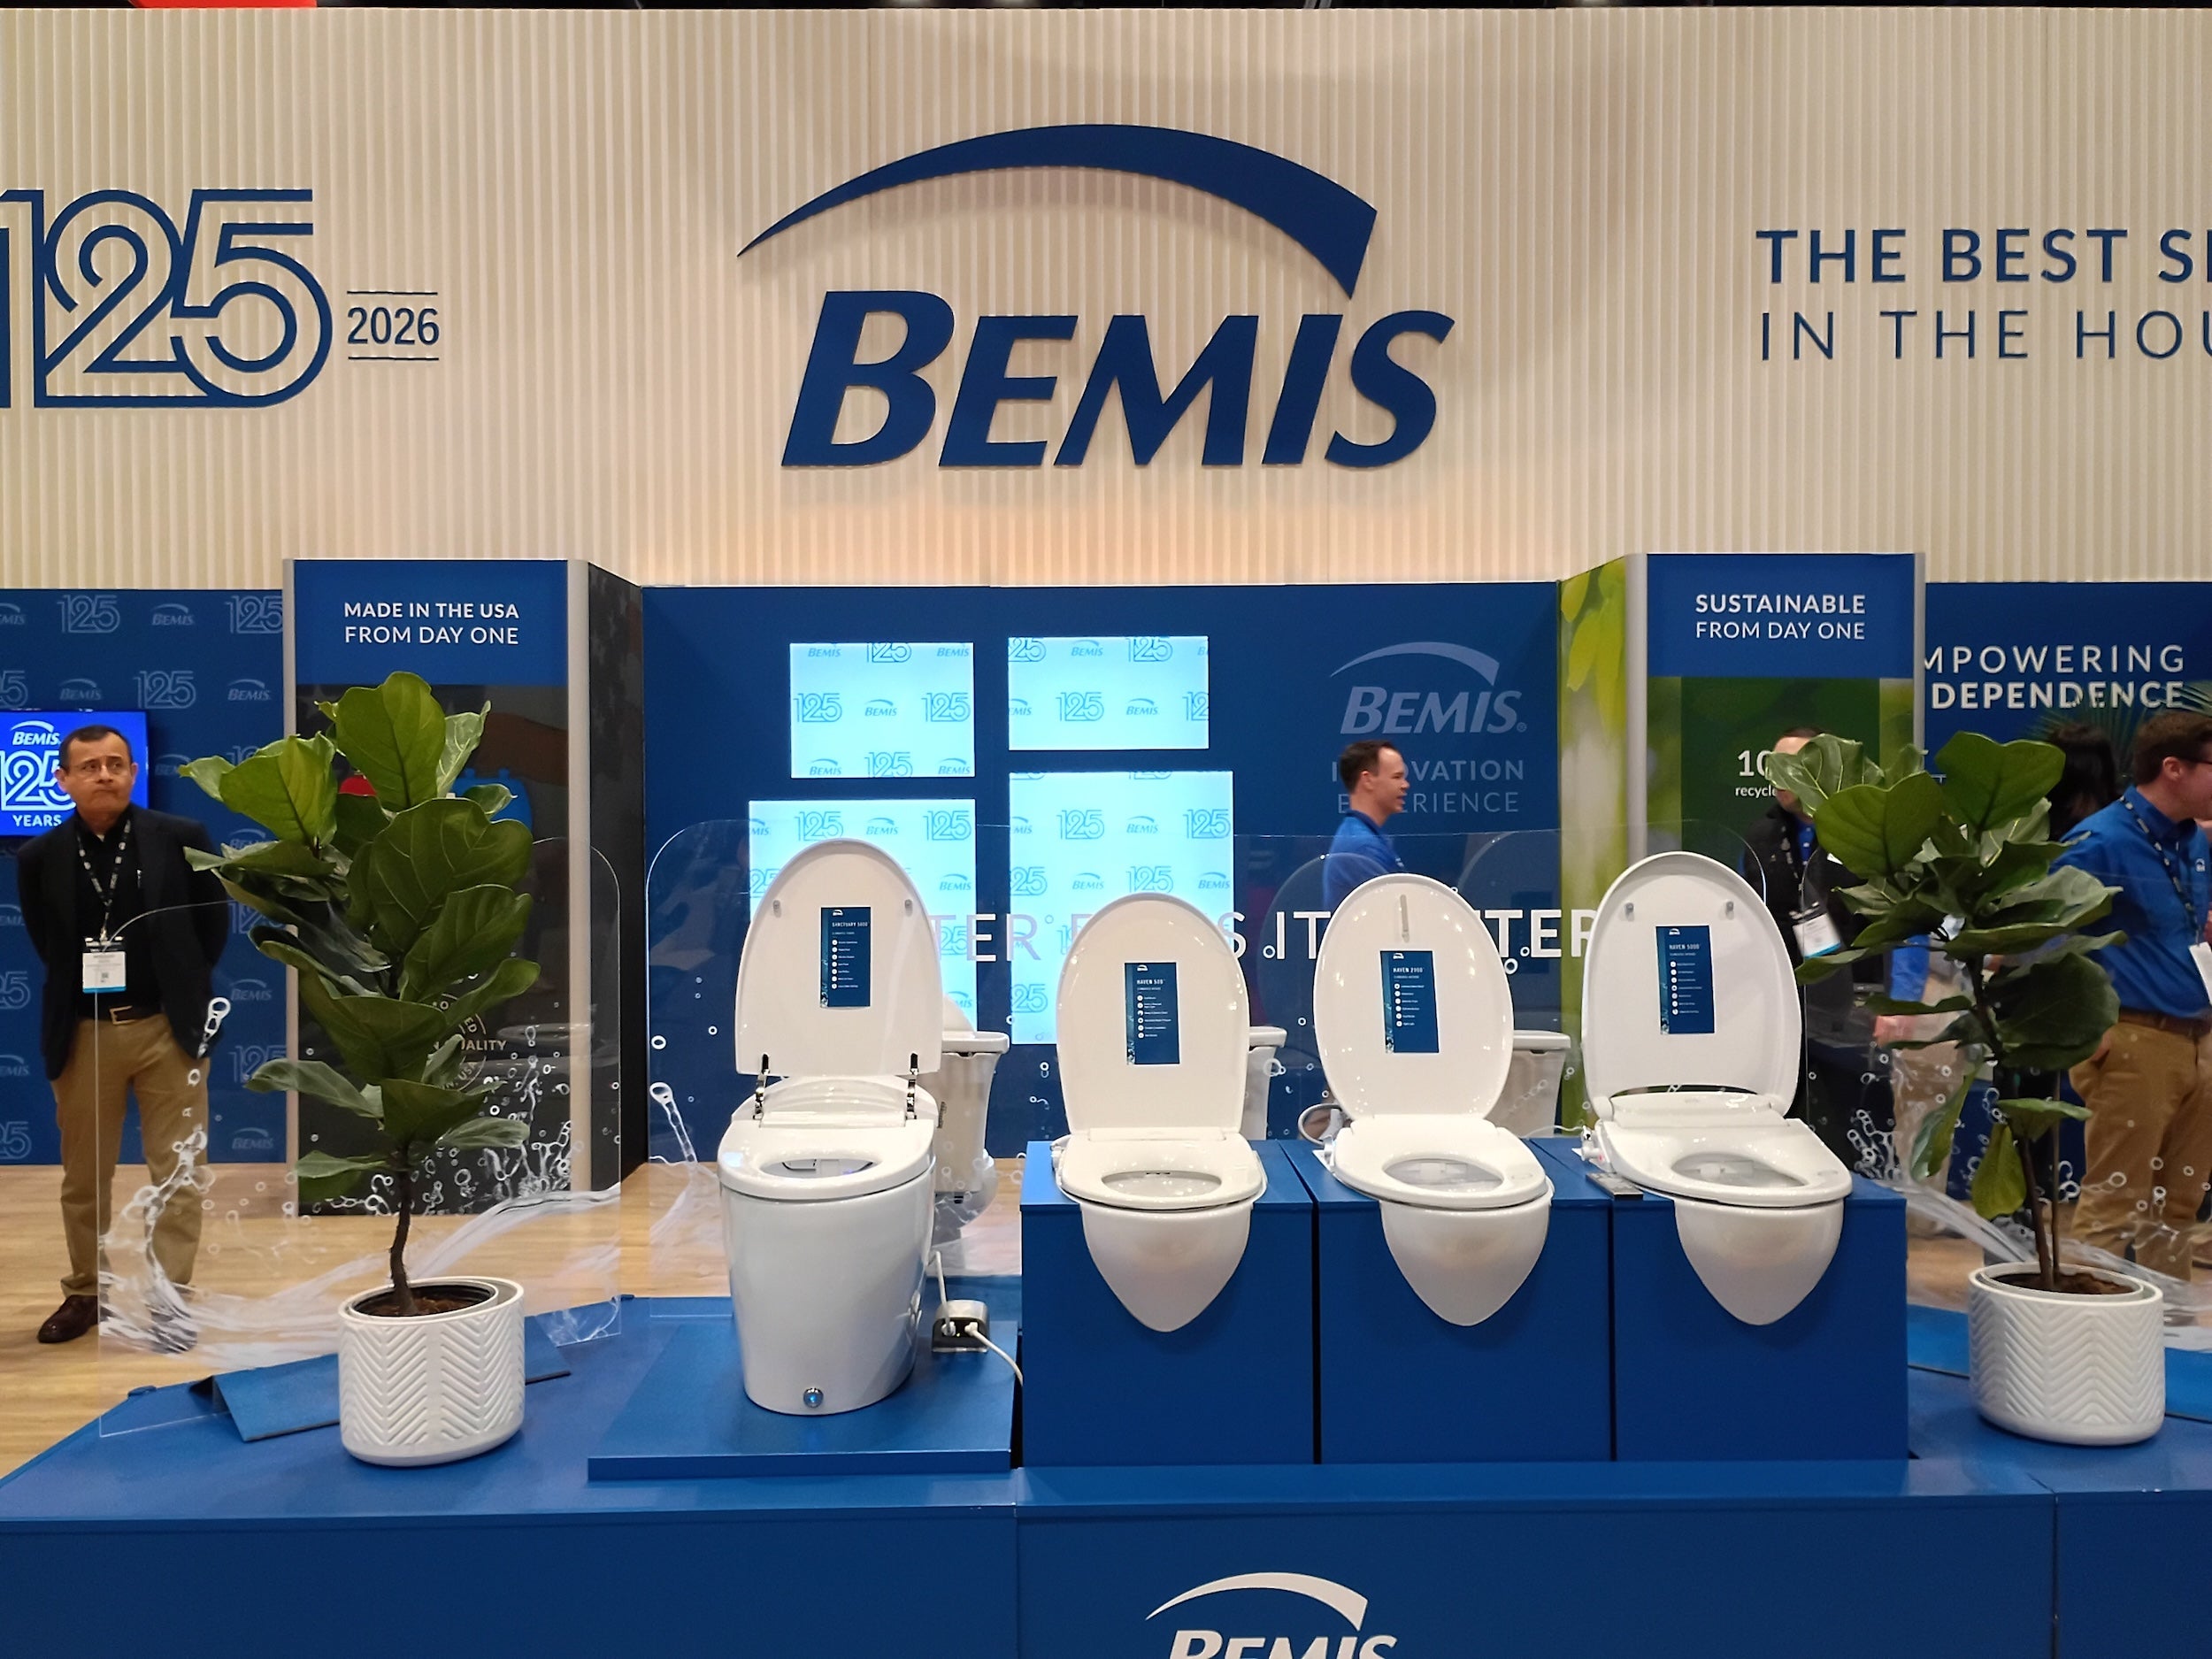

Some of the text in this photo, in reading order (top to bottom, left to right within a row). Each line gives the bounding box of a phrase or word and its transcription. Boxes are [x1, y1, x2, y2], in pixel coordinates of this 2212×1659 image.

[1755, 228, 1907, 283] THE
[1942, 228, 2128, 283] BEST
[0, 188, 333, 408] 125
[347, 306, 440, 345] 2026
[1762, 310, 2212, 360] IN THE HO
[781, 289, 1455, 469] BEMIS
[57, 595, 121, 634] 125
[225, 595, 283, 634] 125
[343, 602, 520, 619] MADE IN THE USA
[1694, 594, 1866, 615] SUSTAINABLE
[151, 613, 194, 626] BEMIS
[344, 626, 519, 645] FROM DAY ONE
[1695, 620, 1865, 641] FROM DAY ONE
[808, 647, 841, 657] BEMIS
[936, 647, 970, 657] BEMIS
[1071, 646, 1104, 657] BEMIS
[1125, 636, 1174, 663] 125
[59, 687, 103, 701] BEMIS
[134, 671, 196, 709] 125
[227, 687, 270, 701] BEMIS
[794, 693, 843, 723] 125
[864, 706, 898, 717] BEMIS
[921, 692, 972, 723] 125
[1056, 692, 1105, 722] 125
[1125, 705, 1159, 716] BEMIS
[12, 731, 60, 746] BEMIS
[809, 766, 842, 776] BEMIS
[864, 751, 913, 778] 125
[938, 765, 971, 775] BEMIS
[1332, 759, 1525, 783] IVATION
[1338, 792, 1519, 814] ERIENCE
[12, 813, 62, 827] YEARS
[794, 810, 844, 841] 125
[865, 826, 899, 835] BEMIS
[922, 810, 972, 841] 125
[1056, 810, 1105, 840] 125
[1125, 823, 1158, 834] BEMIS
[1182, 809, 1232, 839] 125
[939, 881, 972, 891] BEMIS
[1010, 866, 1048, 896] 25
[1071, 879, 1105, 890] BEMIS
[1125, 865, 1174, 893] 125
[1198, 879, 1231, 890] BEMIS
[1276, 910, 1331, 960] IT
[1472, 909, 1598, 958] TER
[231, 988, 272, 1001] BEMIS
